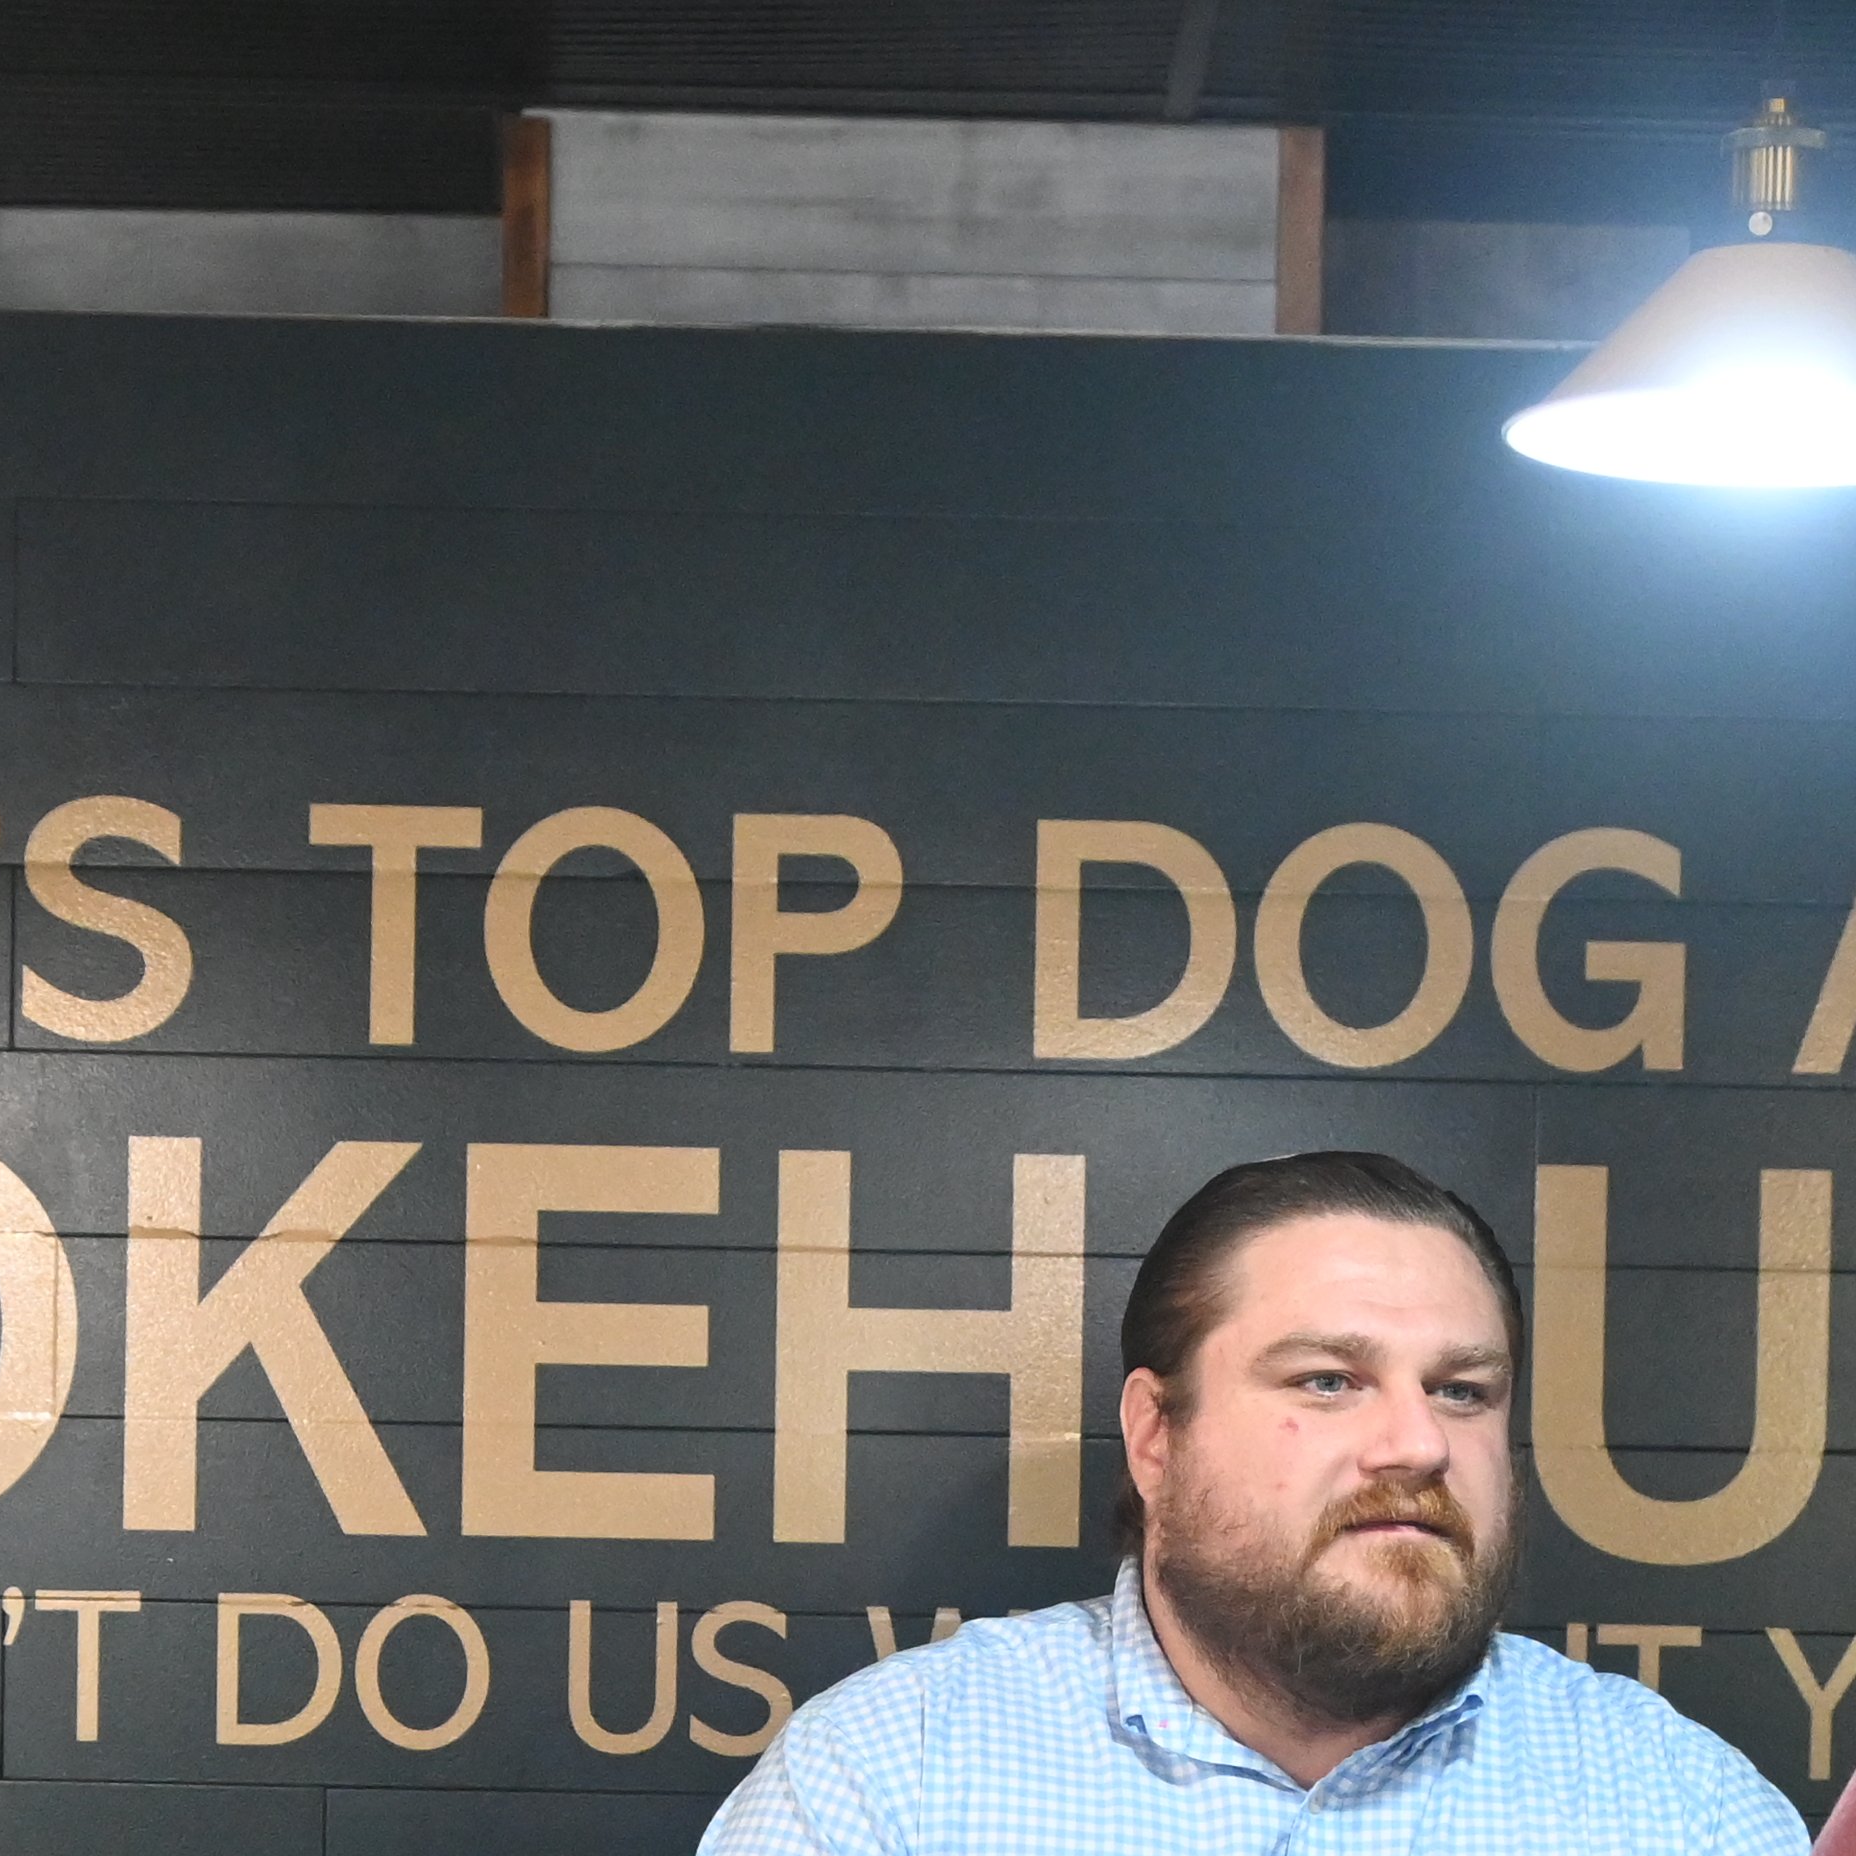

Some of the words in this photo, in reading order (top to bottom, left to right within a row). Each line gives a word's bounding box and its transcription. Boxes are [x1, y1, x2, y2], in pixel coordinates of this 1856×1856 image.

[308, 803, 904, 1053] TOP
[1033, 820, 1687, 1072] DOG
[216, 1591, 491, 1751] DO
[568, 1598, 792, 1758] US
